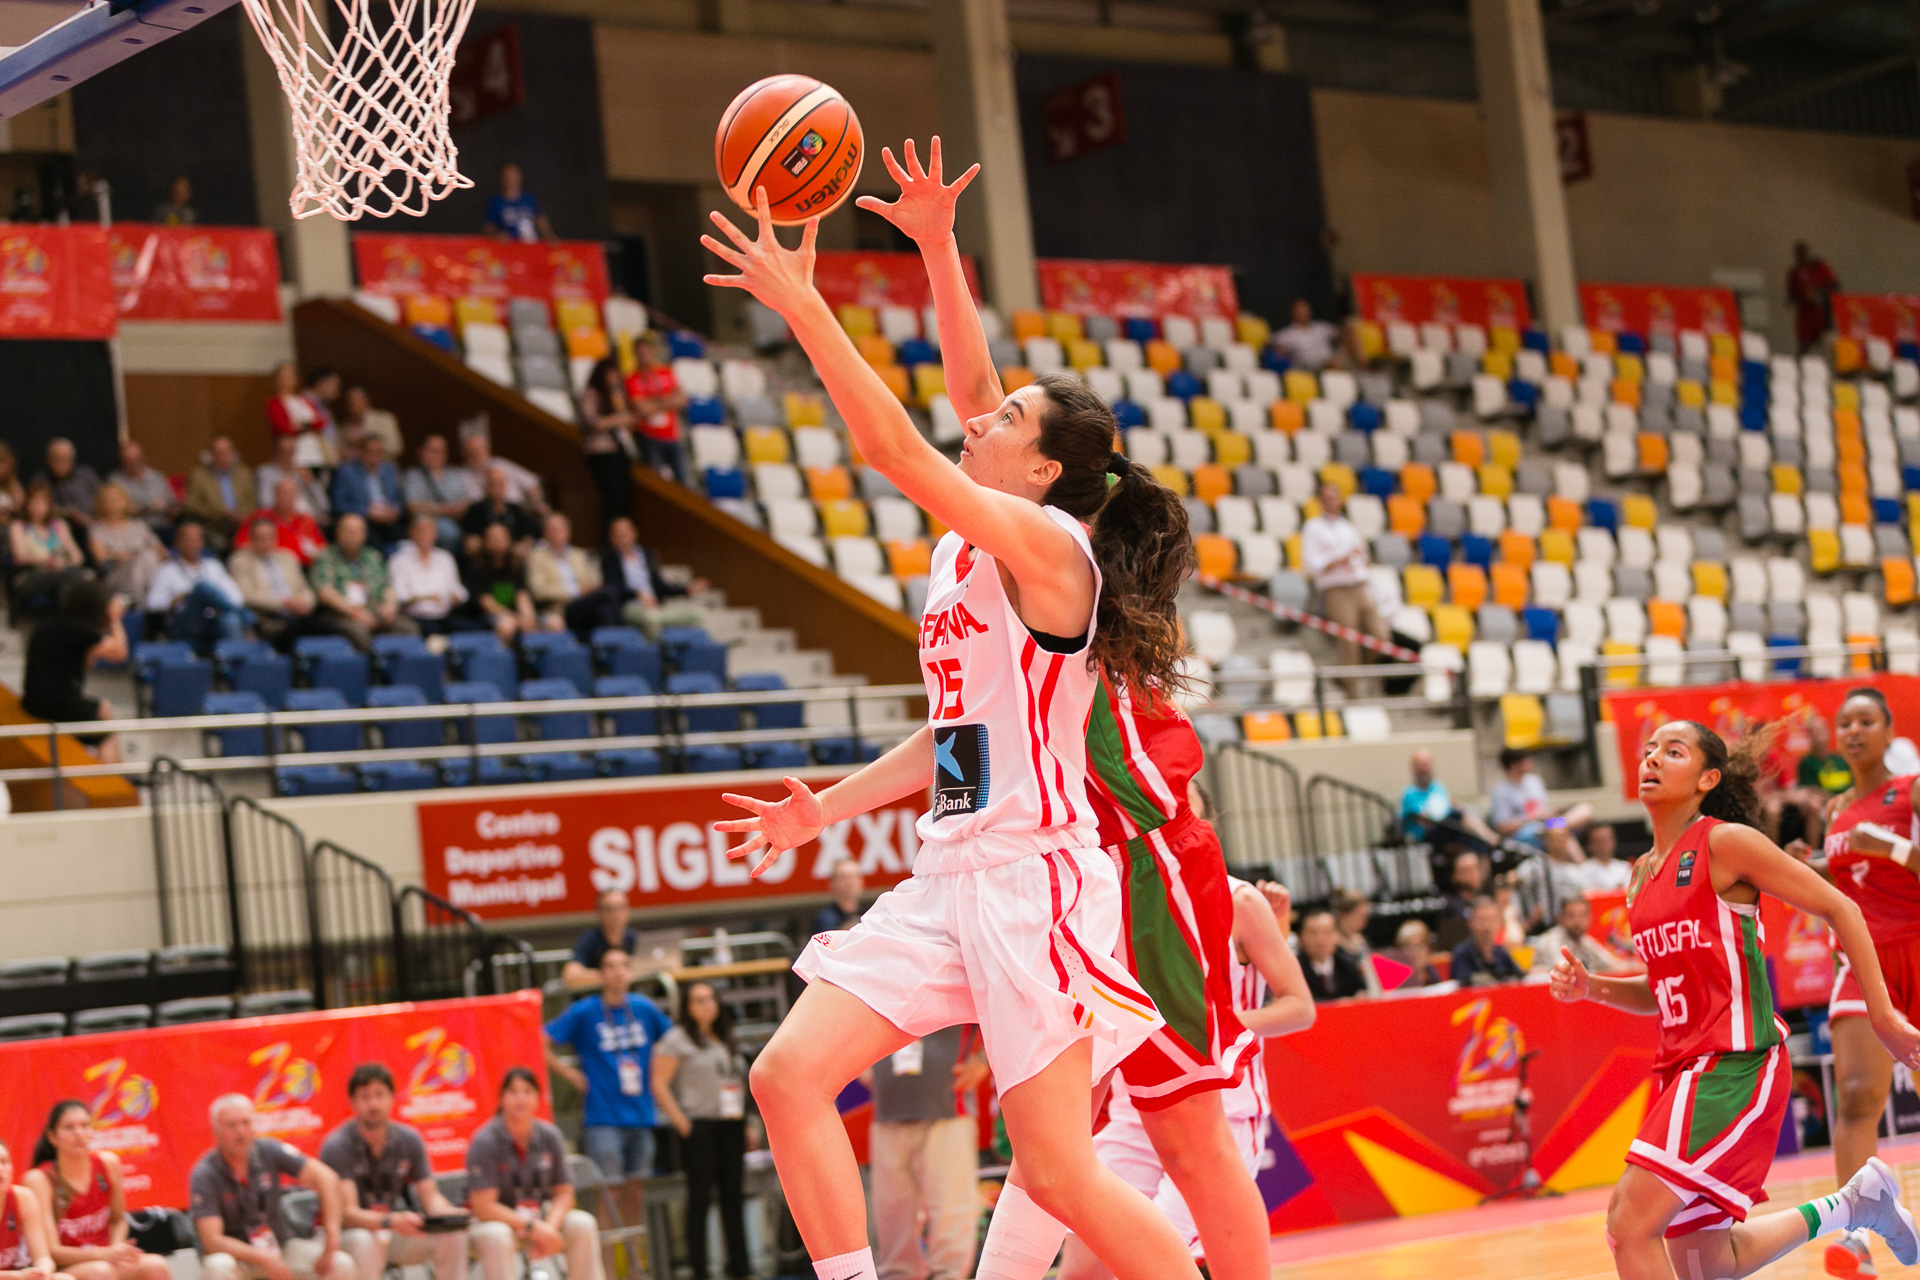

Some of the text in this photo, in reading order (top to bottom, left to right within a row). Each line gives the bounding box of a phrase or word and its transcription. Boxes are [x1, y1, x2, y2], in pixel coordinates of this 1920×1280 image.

[1083, 83, 1115, 141] 3
[795, 142, 858, 212] molten
[926, 657, 965, 721] 15
[475, 809, 562, 840] Centro
[811, 807, 920, 880] XXI
[443, 841, 565, 877] Deportivo
[1850, 860, 1871, 889] 7
[448, 871, 567, 907] Municipal
[1633, 919, 1712, 963] RTUGAL
[1655, 974, 1689, 1028] 15
